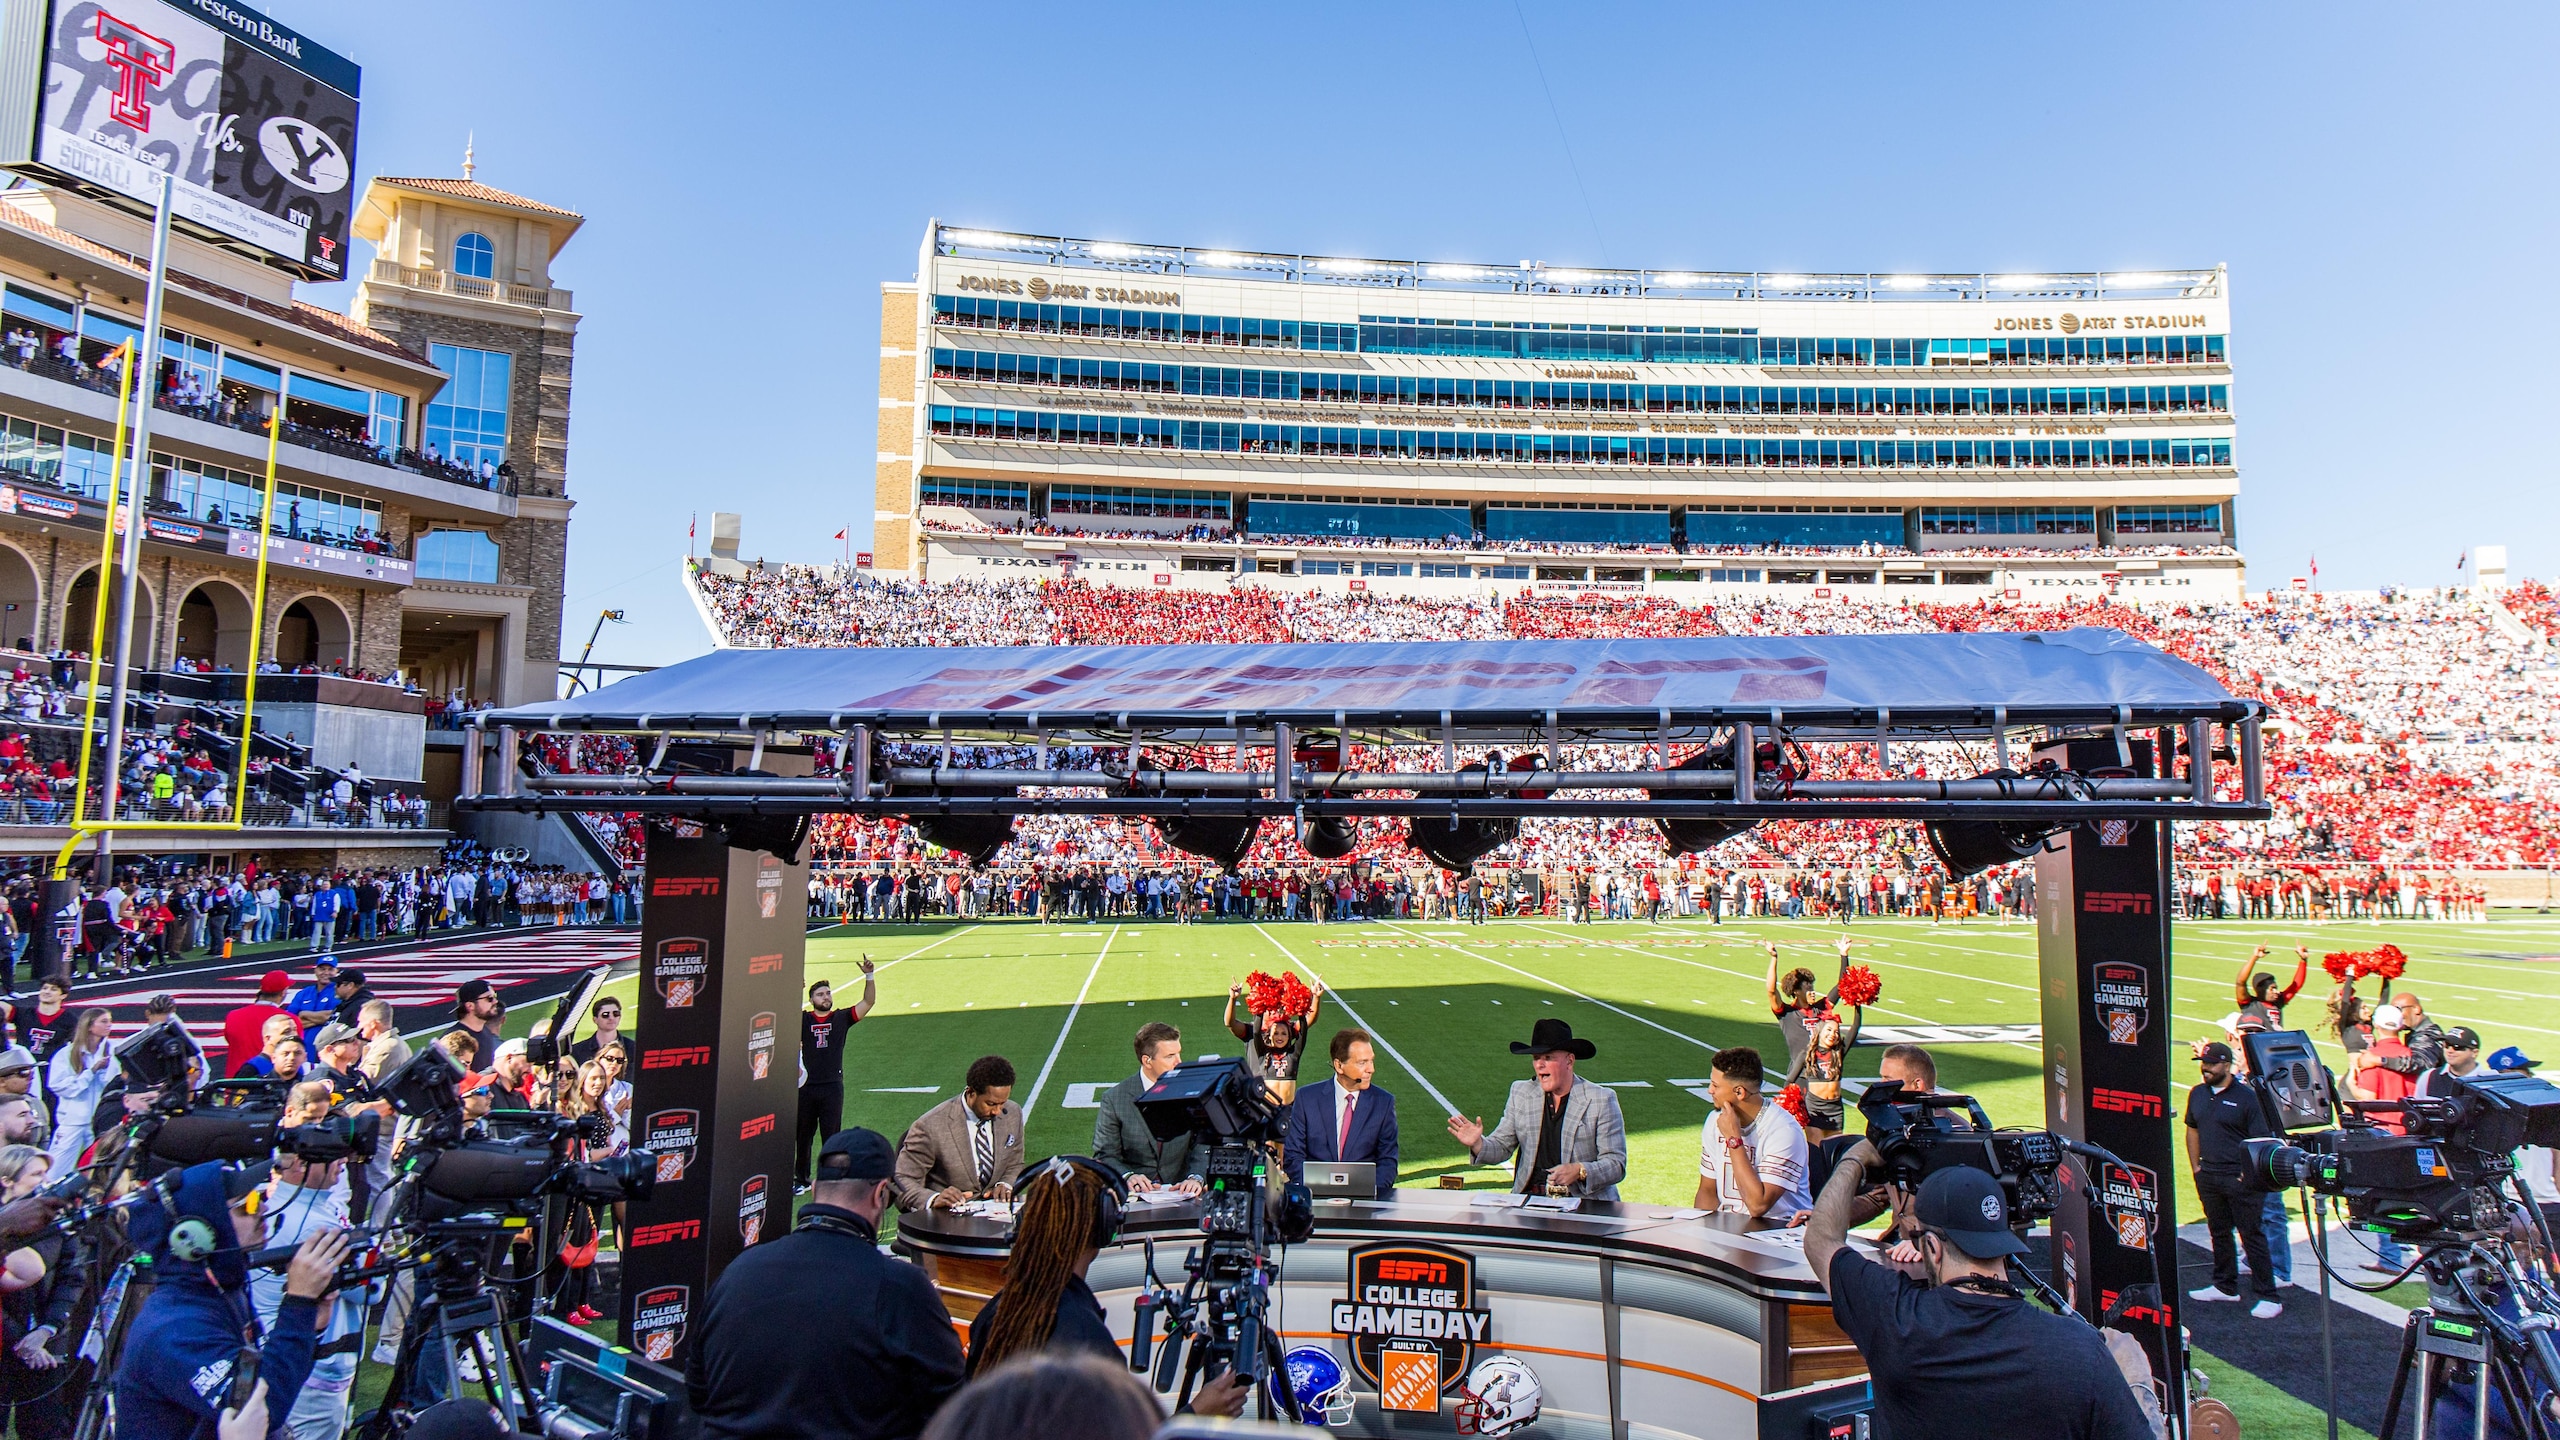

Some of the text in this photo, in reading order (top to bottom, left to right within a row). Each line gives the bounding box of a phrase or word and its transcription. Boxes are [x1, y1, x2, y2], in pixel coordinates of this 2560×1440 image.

[191, 0, 302, 59] estern Bank
[194, 112, 244, 153] Vs.
[88, 128, 166, 170] TEXAS TECH
[276, 124, 335, 185] Y
[60, 144, 130, 190] SOCIAL!
[288, 208, 312, 229] BYU
[957, 275, 1180, 306] JONES AT&T STADIUM
[1994, 315, 2206, 330] JONES AT&T STADIUM
[858, 555, 871, 563] 102
[978, 557, 1147, 571] TEXAS TECH
[1156, 575, 1169, 583] 103
[1351, 581, 1364, 589] 104
[1577, 584, 1643, 592] RAIDERS
[2028, 578, 2191, 586] TEXAS TECH
[842, 657, 1829, 710] ESPN
[757, 878, 783, 888] GAMEDAY
[760, 870, 780, 878] COLLEGE
[652, 877, 720, 897] ESPN
[2084, 891, 2152, 915] ESPN
[668, 943, 698, 953] ESPN
[655, 964, 708, 977] GAMEDAY
[662, 956, 702, 966] COLLEGE
[749, 953, 783, 974] ESPN
[2105, 968, 2136, 981] ESPN
[667, 980, 694, 1008] HOME
[2100, 983, 2141, 996] COLLEGE
[2094, 993, 2149, 1008] GAMEDAY
[2109, 1013, 2136, 1043] HOME
[2111, 1016, 2123, 1028] THE
[748, 1037, 775, 1051] GAMEDAY
[752, 1029, 773, 1041] COLLEGE
[642, 1046, 711, 1070] ESPN
[2092, 1087, 2162, 1118] ESPN
[658, 1114, 688, 1126] ESPN
[740, 1113, 775, 1140] ESPN
[644, 1136, 699, 1150] GAMEDAY
[652, 1128, 692, 1140] COLLEGE
[656, 1153, 685, 1182] HOME
[739, 1199, 767, 1218] GAMEDAY
[743, 1192, 765, 1206] COLLEGE
[630, 1219, 701, 1247] ESPN
[2119, 1217, 2145, 1247] HOME
[2121, 1217, 2131, 1230] THE
[1378, 1259, 1448, 1283] ESPN
[646, 1291, 678, 1305] ESPN
[1365, 1285, 1458, 1309] COLLEGE
[641, 1304, 682, 1319] COLLEGE
[633, 1312, 688, 1331] GAMEDAY
[1333, 1304, 1489, 1341] GAMEDAY
[646, 1330, 674, 1361] HOME
[1392, 1341, 1428, 1351] BUILT BY
[1390, 1361, 1410, 1380] THE
[1384, 1354, 1437, 1409] HOME
[1405, 1377, 1437, 1410] DEPOT
